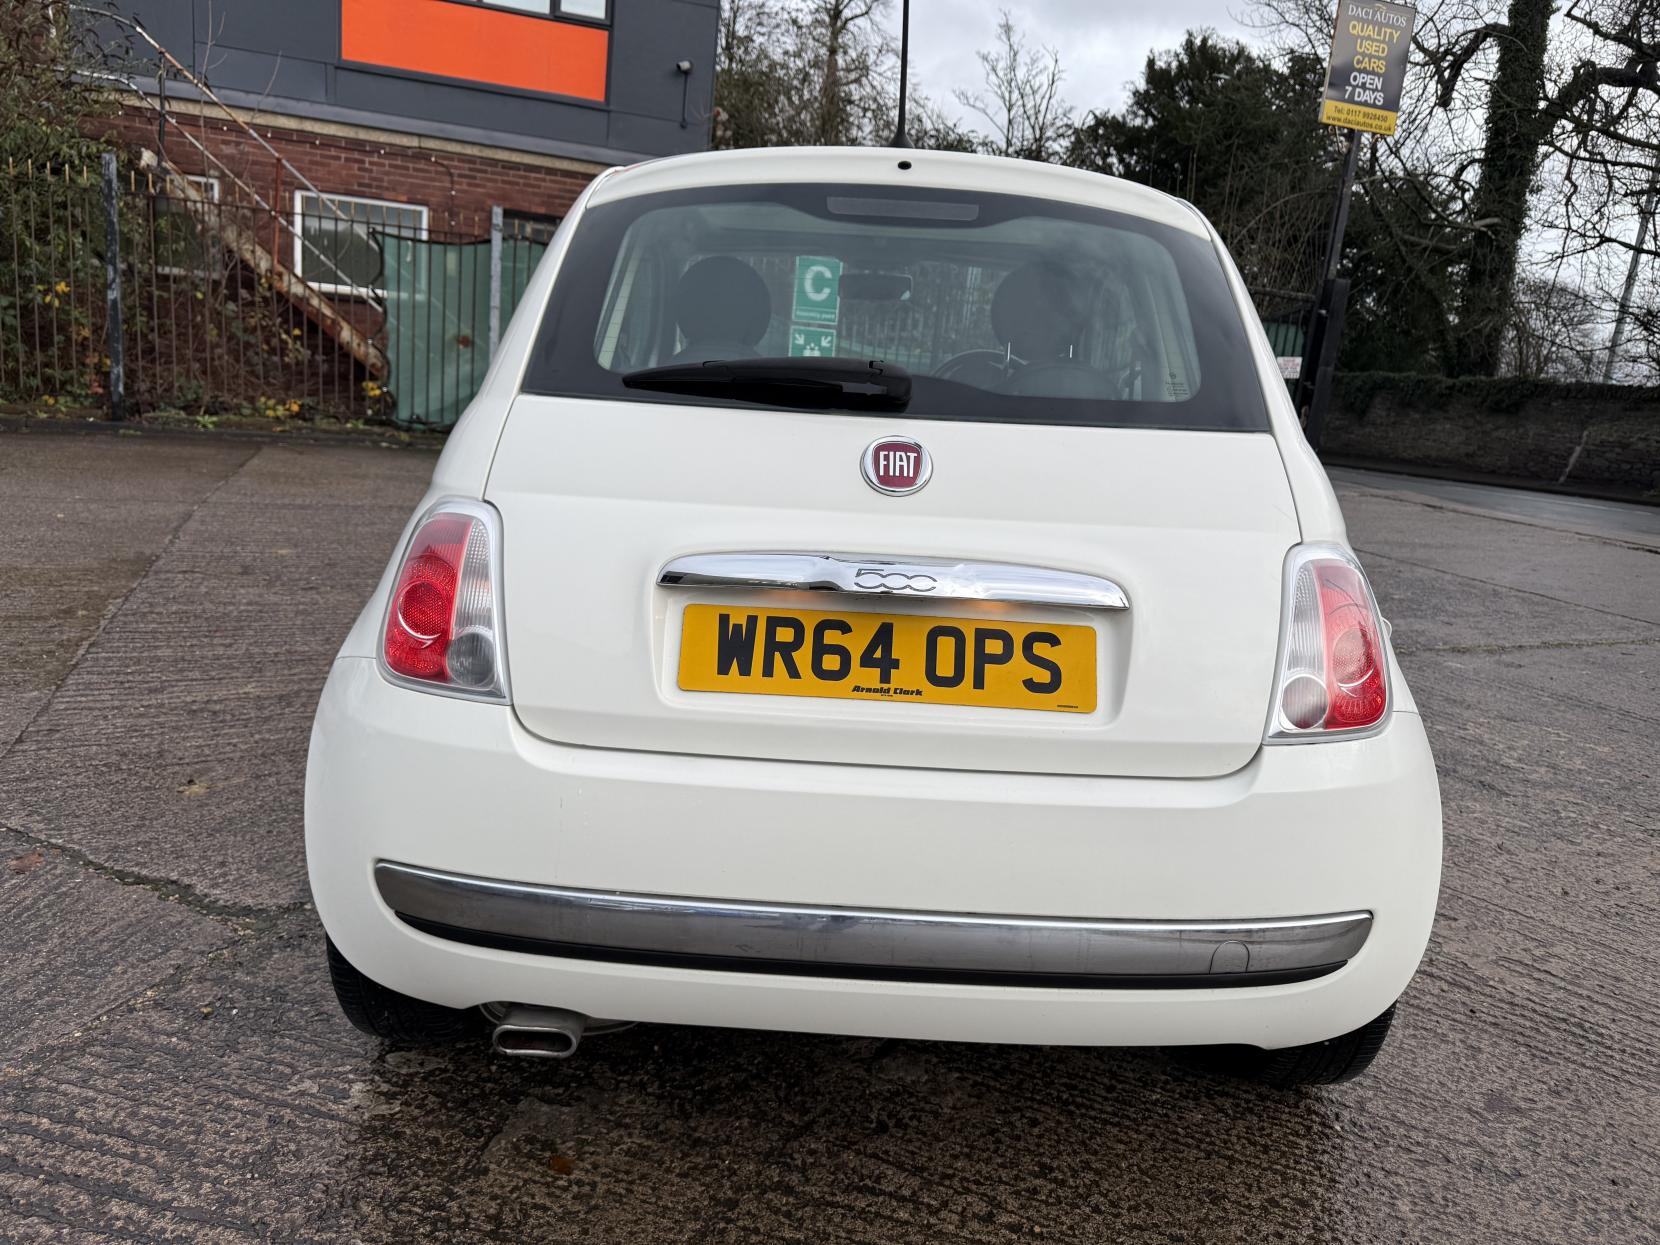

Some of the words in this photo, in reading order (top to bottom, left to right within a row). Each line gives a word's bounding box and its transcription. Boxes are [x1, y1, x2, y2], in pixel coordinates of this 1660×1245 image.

[1348, 4, 1372, 19] DACI
[1373, 8, 1407, 28] AUTOS
[1349, 21, 1401, 43] QUALITY
[1356, 39, 1388, 57] USED
[1353, 55, 1386, 74] CARS
[1350, 72, 1383, 90] OPEN
[1344, 86, 1352, 99] 7
[1354, 88, 1384, 105] DAYS
[804, 265, 832, 301] C
[879, 451, 918, 477] FIAT
[854, 568, 938, 592] 500
[716, 612, 900, 685] WR64
[925, 625, 1063, 695] OPS
[851, 685, 891, 694] Arnold
[893, 687, 923, 696] Clark
